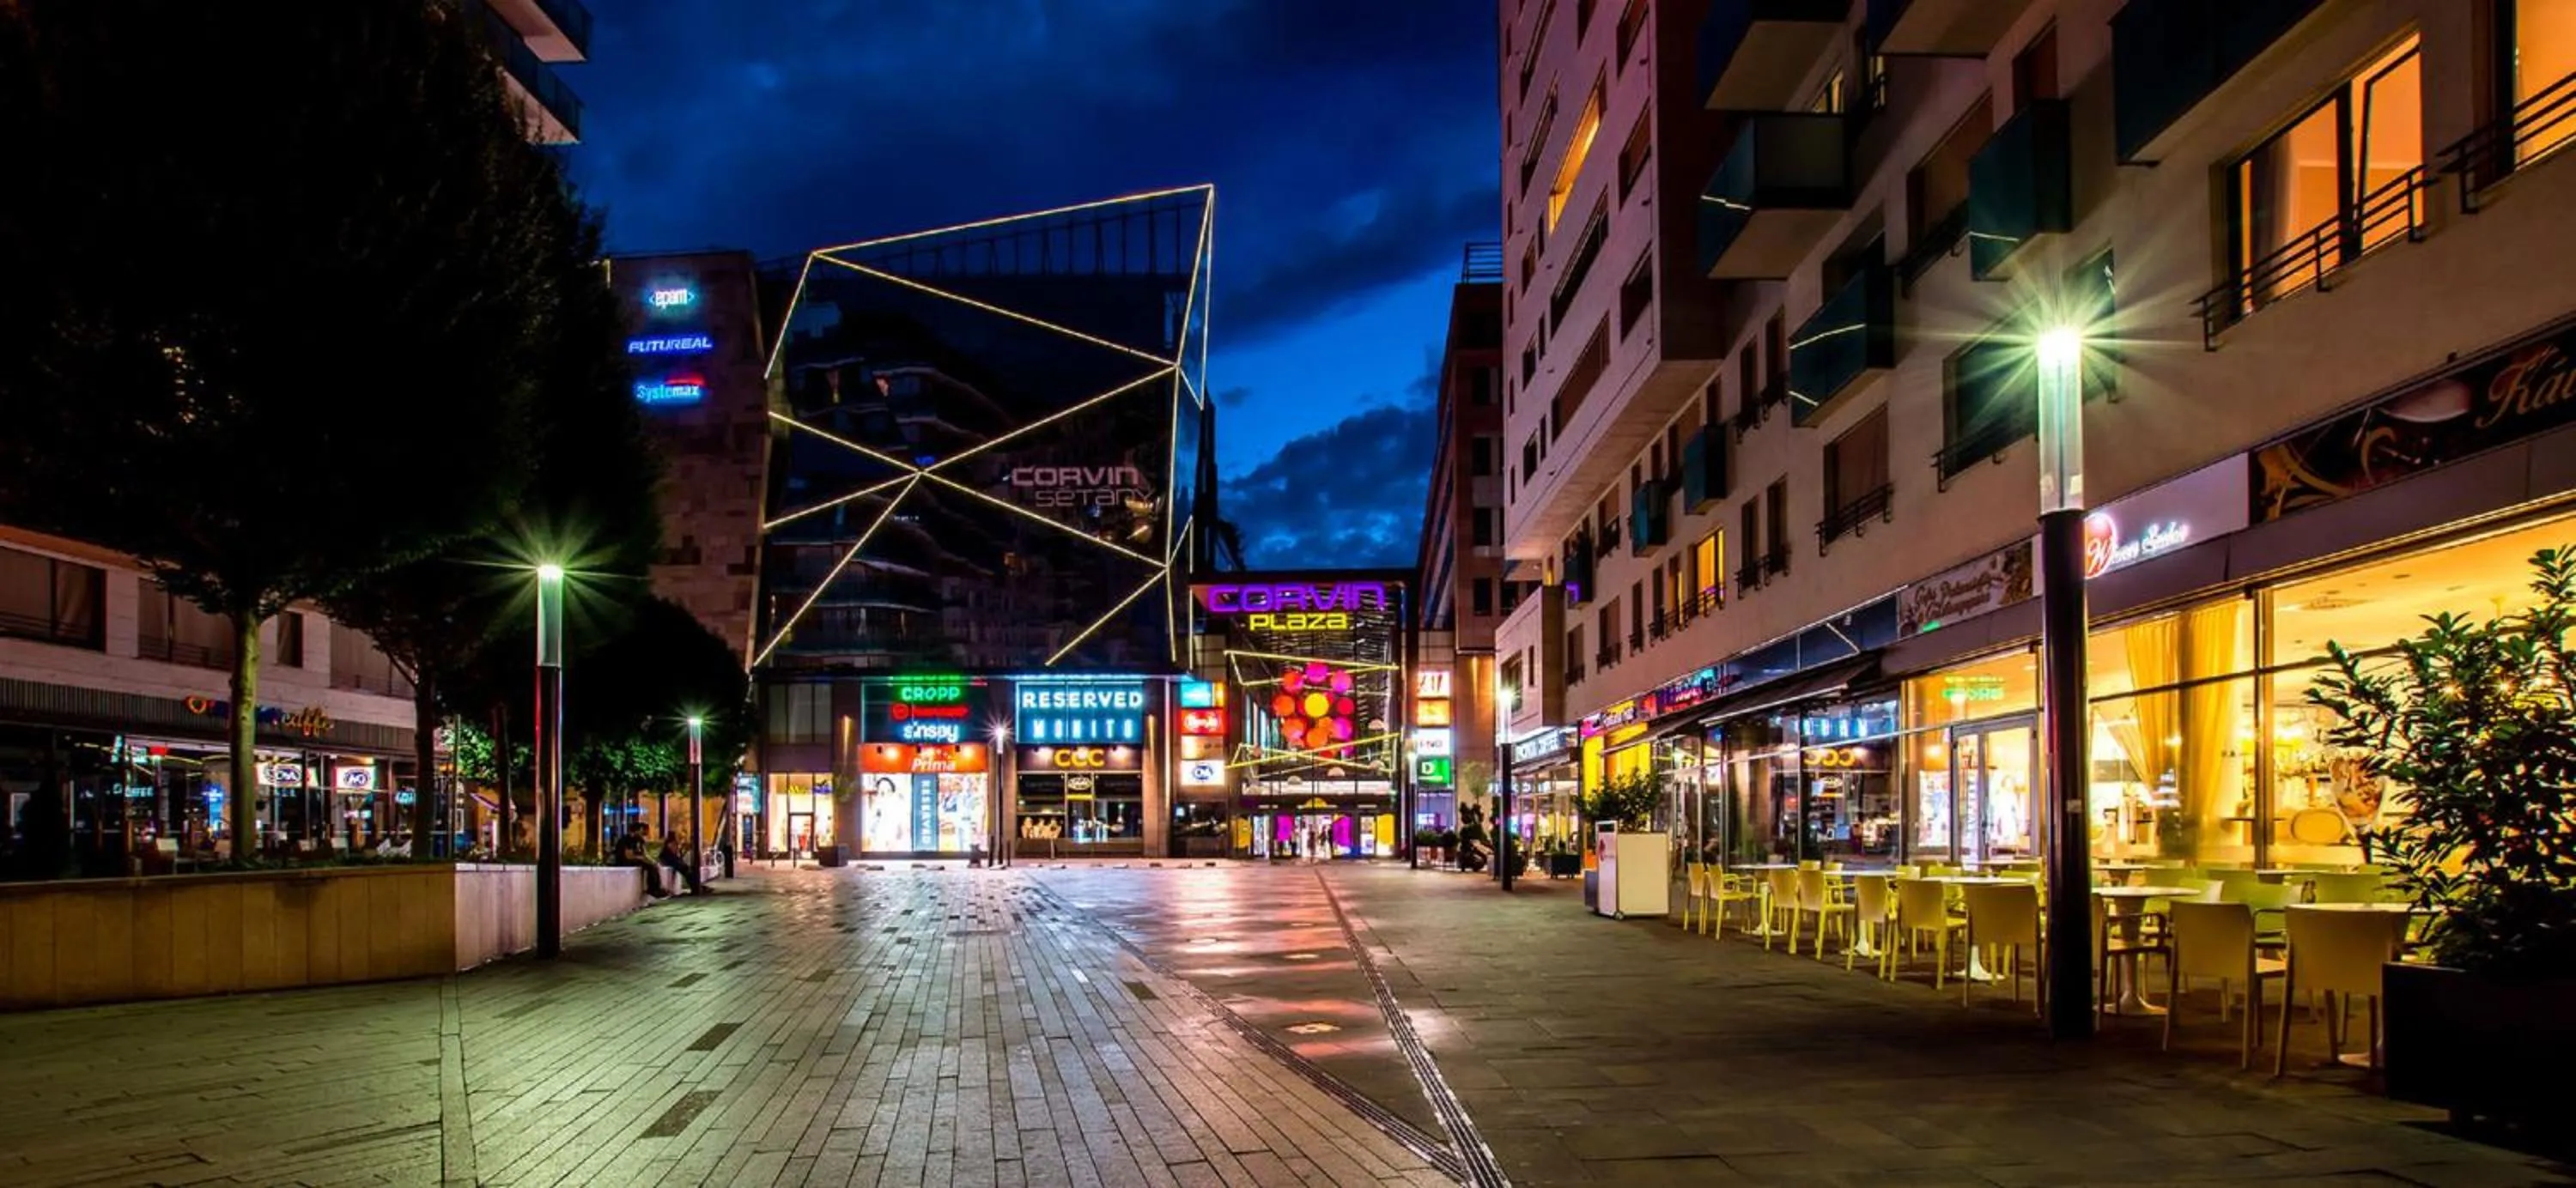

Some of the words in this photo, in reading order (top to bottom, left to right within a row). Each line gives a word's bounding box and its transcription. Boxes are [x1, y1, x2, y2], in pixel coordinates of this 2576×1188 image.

[628, 336, 713, 353] FUTUREAL
[636, 385, 701, 403] Systemax
[1012, 466, 1140, 486] CORVIN
[1208, 584, 1387, 611] CORVIN
[1249, 614, 1347, 631] PLAZA
[901, 686, 961, 701] CROPP
[1022, 691, 1143, 708] RESERVED
[1054, 749, 1104, 767] CCC
